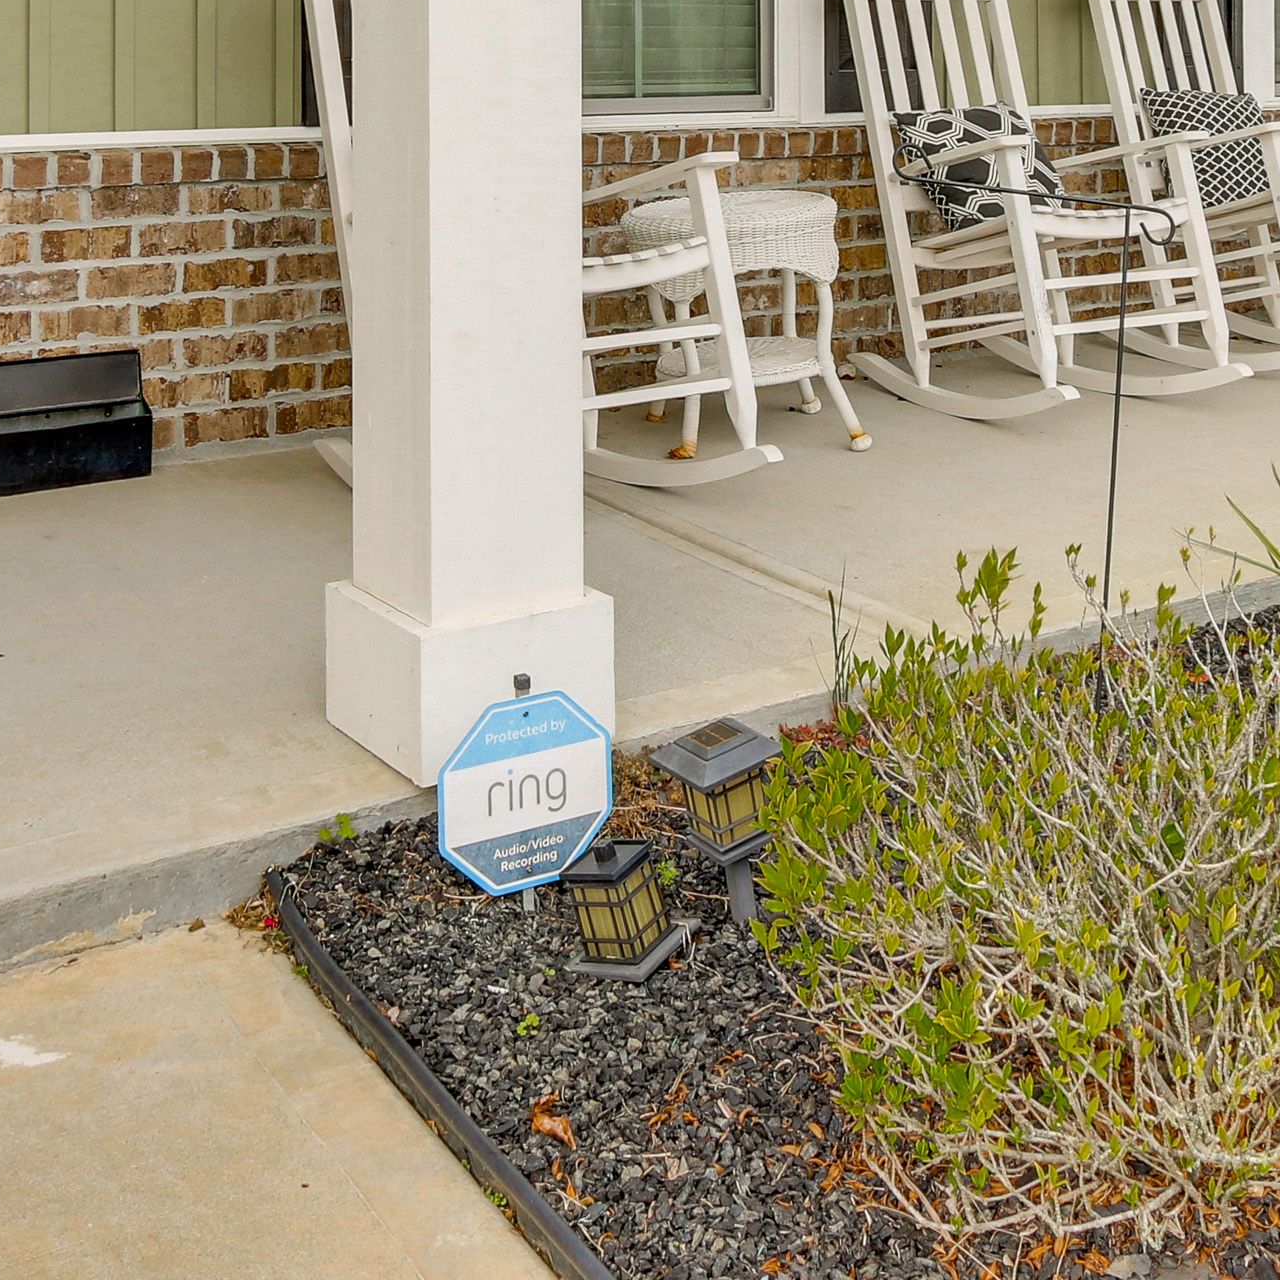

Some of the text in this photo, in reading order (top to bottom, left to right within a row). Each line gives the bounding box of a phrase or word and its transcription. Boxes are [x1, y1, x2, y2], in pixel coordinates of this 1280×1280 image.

[485, 719, 567, 745] Protected by
[487, 767, 567, 817] ring
[493, 834, 564, 861] Audio/Video
[501, 851, 558, 872] Recording
